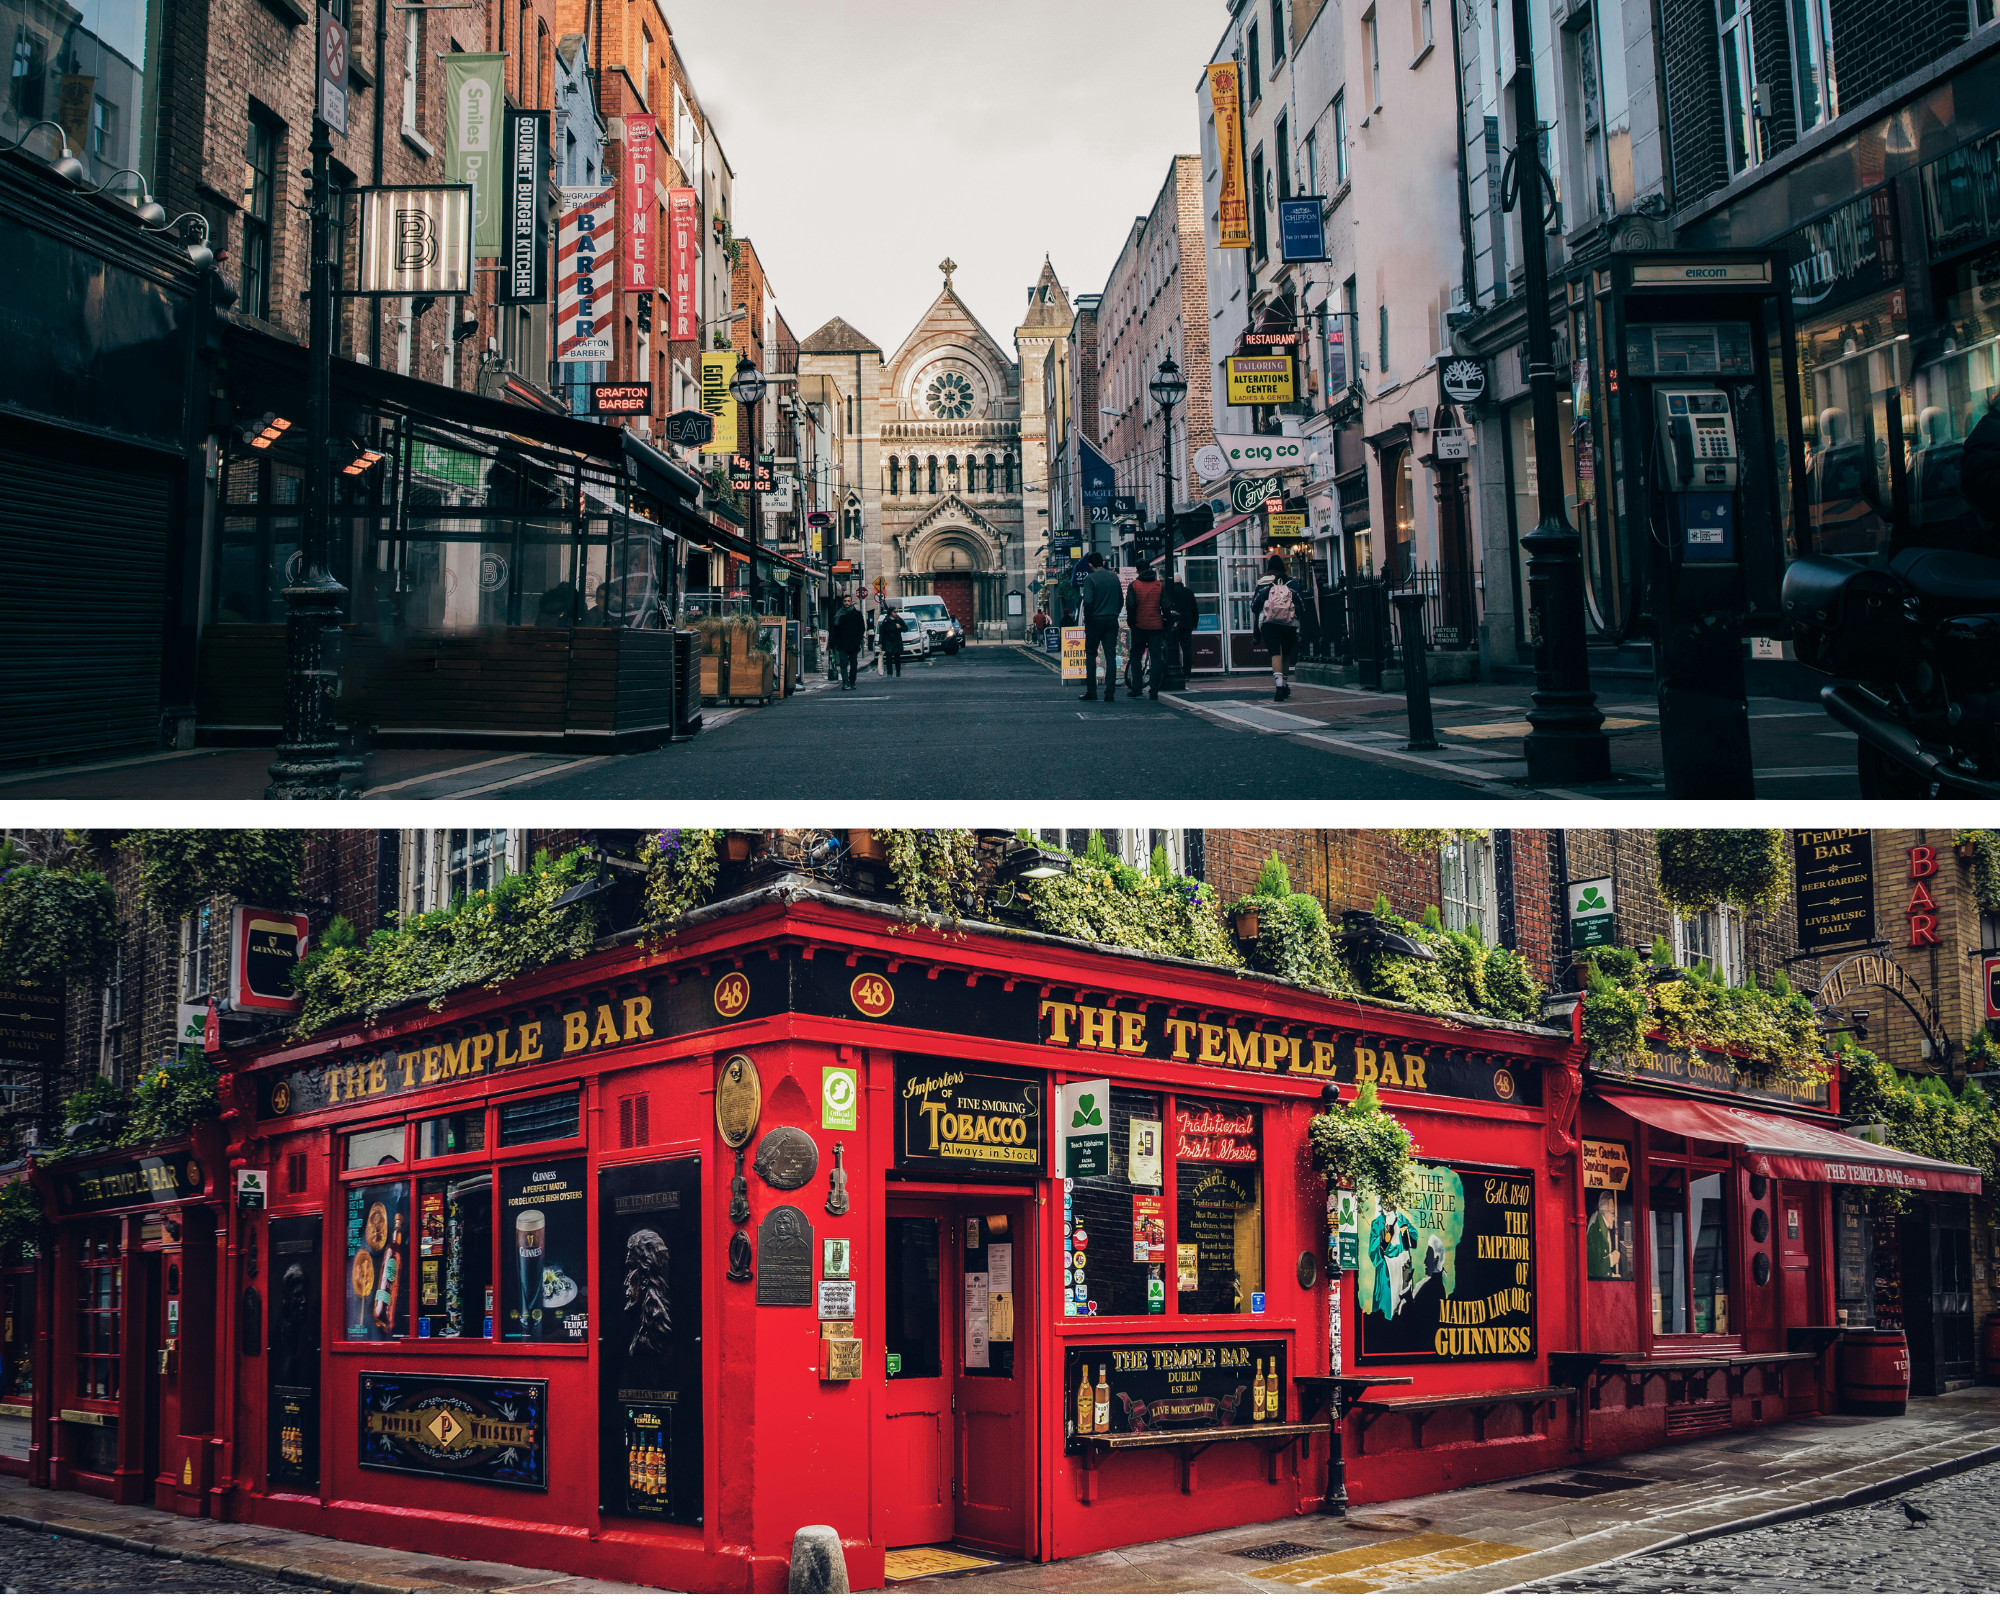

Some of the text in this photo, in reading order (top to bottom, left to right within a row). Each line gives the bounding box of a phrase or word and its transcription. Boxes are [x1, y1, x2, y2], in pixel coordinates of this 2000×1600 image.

[467, 87, 484, 146] Smiles
[1225, 114, 1235, 198] ALTERATION
[571, 192, 611, 200] GRAFTON
[516, 116, 533, 297] GOURMET BURGER KITCHEN
[1221, 201, 1245, 220] CENTRE
[633, 163, 646, 284] DINER
[395, 209, 438, 270] B
[576, 214, 596, 338] BARBER
[678, 231, 688, 335] DINER
[1246, 334, 1295, 345] RESTAURANT
[1238, 362, 1283, 370] TAILORING
[1234, 375, 1289, 384] ALTERATIONS
[596, 387, 648, 398] GRAFTON
[703, 365, 730, 417] GOTHAM
[1246, 385, 1278, 393] CENTRE
[599, 399, 644, 410] BARBER
[670, 418, 711, 440] EAT
[1231, 445, 1299, 462] e cig co
[732, 481, 771, 490] LOUGE
[1092, 507, 1109, 520] 22
[1076, 572, 1089, 580] 22
[1066, 630, 1086, 639] TAILOR
[1814, 843, 1853, 860] BAR
[1801, 873, 1868, 892] BEER GARDEN
[1906, 845, 1941, 948] BAR
[1805, 909, 1866, 926] LIVE MUSIC
[1819, 923, 1852, 935] DAILY
[252, 945, 293, 958] GUINNESS
[1820, 956, 1911, 1006] THE TEMPLE
[19, 993, 60, 1004] GARDEN
[720, 979, 743, 1010] 48
[857, 981, 885, 1008] 48
[21, 1030, 57, 1041] MUSIC
[8, 1040, 41, 1051] DAILY
[325, 995, 655, 1104] THE TEMPLE BAR
[1042, 1000, 1428, 1090] THE TEMPLE BAR
[902, 1071, 964, 1099] Importers
[1497, 1074, 1512, 1094] 48
[275, 1088, 288, 1109] 48
[941, 1089, 953, 1099] OF
[830, 1109, 850, 1117] Official
[957, 1096, 1026, 1115] FINE SMOKING
[828, 1116, 852, 1124] Member
[920, 1100, 1028, 1151] TOBACCO
[1176, 1113, 1254, 1135] Traditional
[942, 1144, 1036, 1162] Always in Stock
[1083, 1148, 1092, 1156] Pub
[1583, 1143, 1621, 1161] Beer Garden
[532, 1171, 557, 1182] GUINNESS
[1583, 1158, 1609, 1177] Smoking
[1825, 1163, 1905, 1185] THE TEMPLE BAR
[79, 1165, 179, 1201] THE TEMPLE BAR
[527, 1183, 548, 1193] PERFECT
[549, 1182, 567, 1191] MATCH
[1192, 1175, 1246, 1200] TEMPLE BAR
[1418, 1174, 1444, 1193] THE
[1589, 1173, 1604, 1187] Area
[508, 1191, 583, 1206] FOR DELICIOUS IRISH OYSTERS
[662, 1192, 679, 1203] BAR
[1192, 1199, 1234, 1207] Traditional Food
[1408, 1192, 1457, 1213] TEMPLE
[1510, 1184, 1530, 1207] 1840
[1419, 1212, 1445, 1231] BAR
[1504, 1211, 1529, 1235] THE
[1846, 1215, 1858, 1228] BAR
[519, 1247, 542, 1258] GUINNESS
[1200, 1252, 1209, 1260] Hot
[1477, 1235, 1530, 1260] EMPEROR
[1515, 1262, 1529, 1285] OF
[1439, 1287, 1532, 1324] MALTED LIQUORS
[563, 1321, 588, 1329] TEMPLE
[570, 1314, 581, 1323] THE
[569, 1328, 583, 1337] BAR
[1435, 1326, 1531, 1356] GUINNESS
[1112, 1347, 1251, 1371] THE TEMPLE BAR
[1168, 1371, 1202, 1383] DUBLIN
[653, 1391, 677, 1400] TEMPLE
[1171, 1384, 1198, 1394] EST. 1840
[1152, 1402, 1216, 1417] LIVE MUSIC DAILY
[381, 1414, 523, 1442] POWERS P WHISKEY
